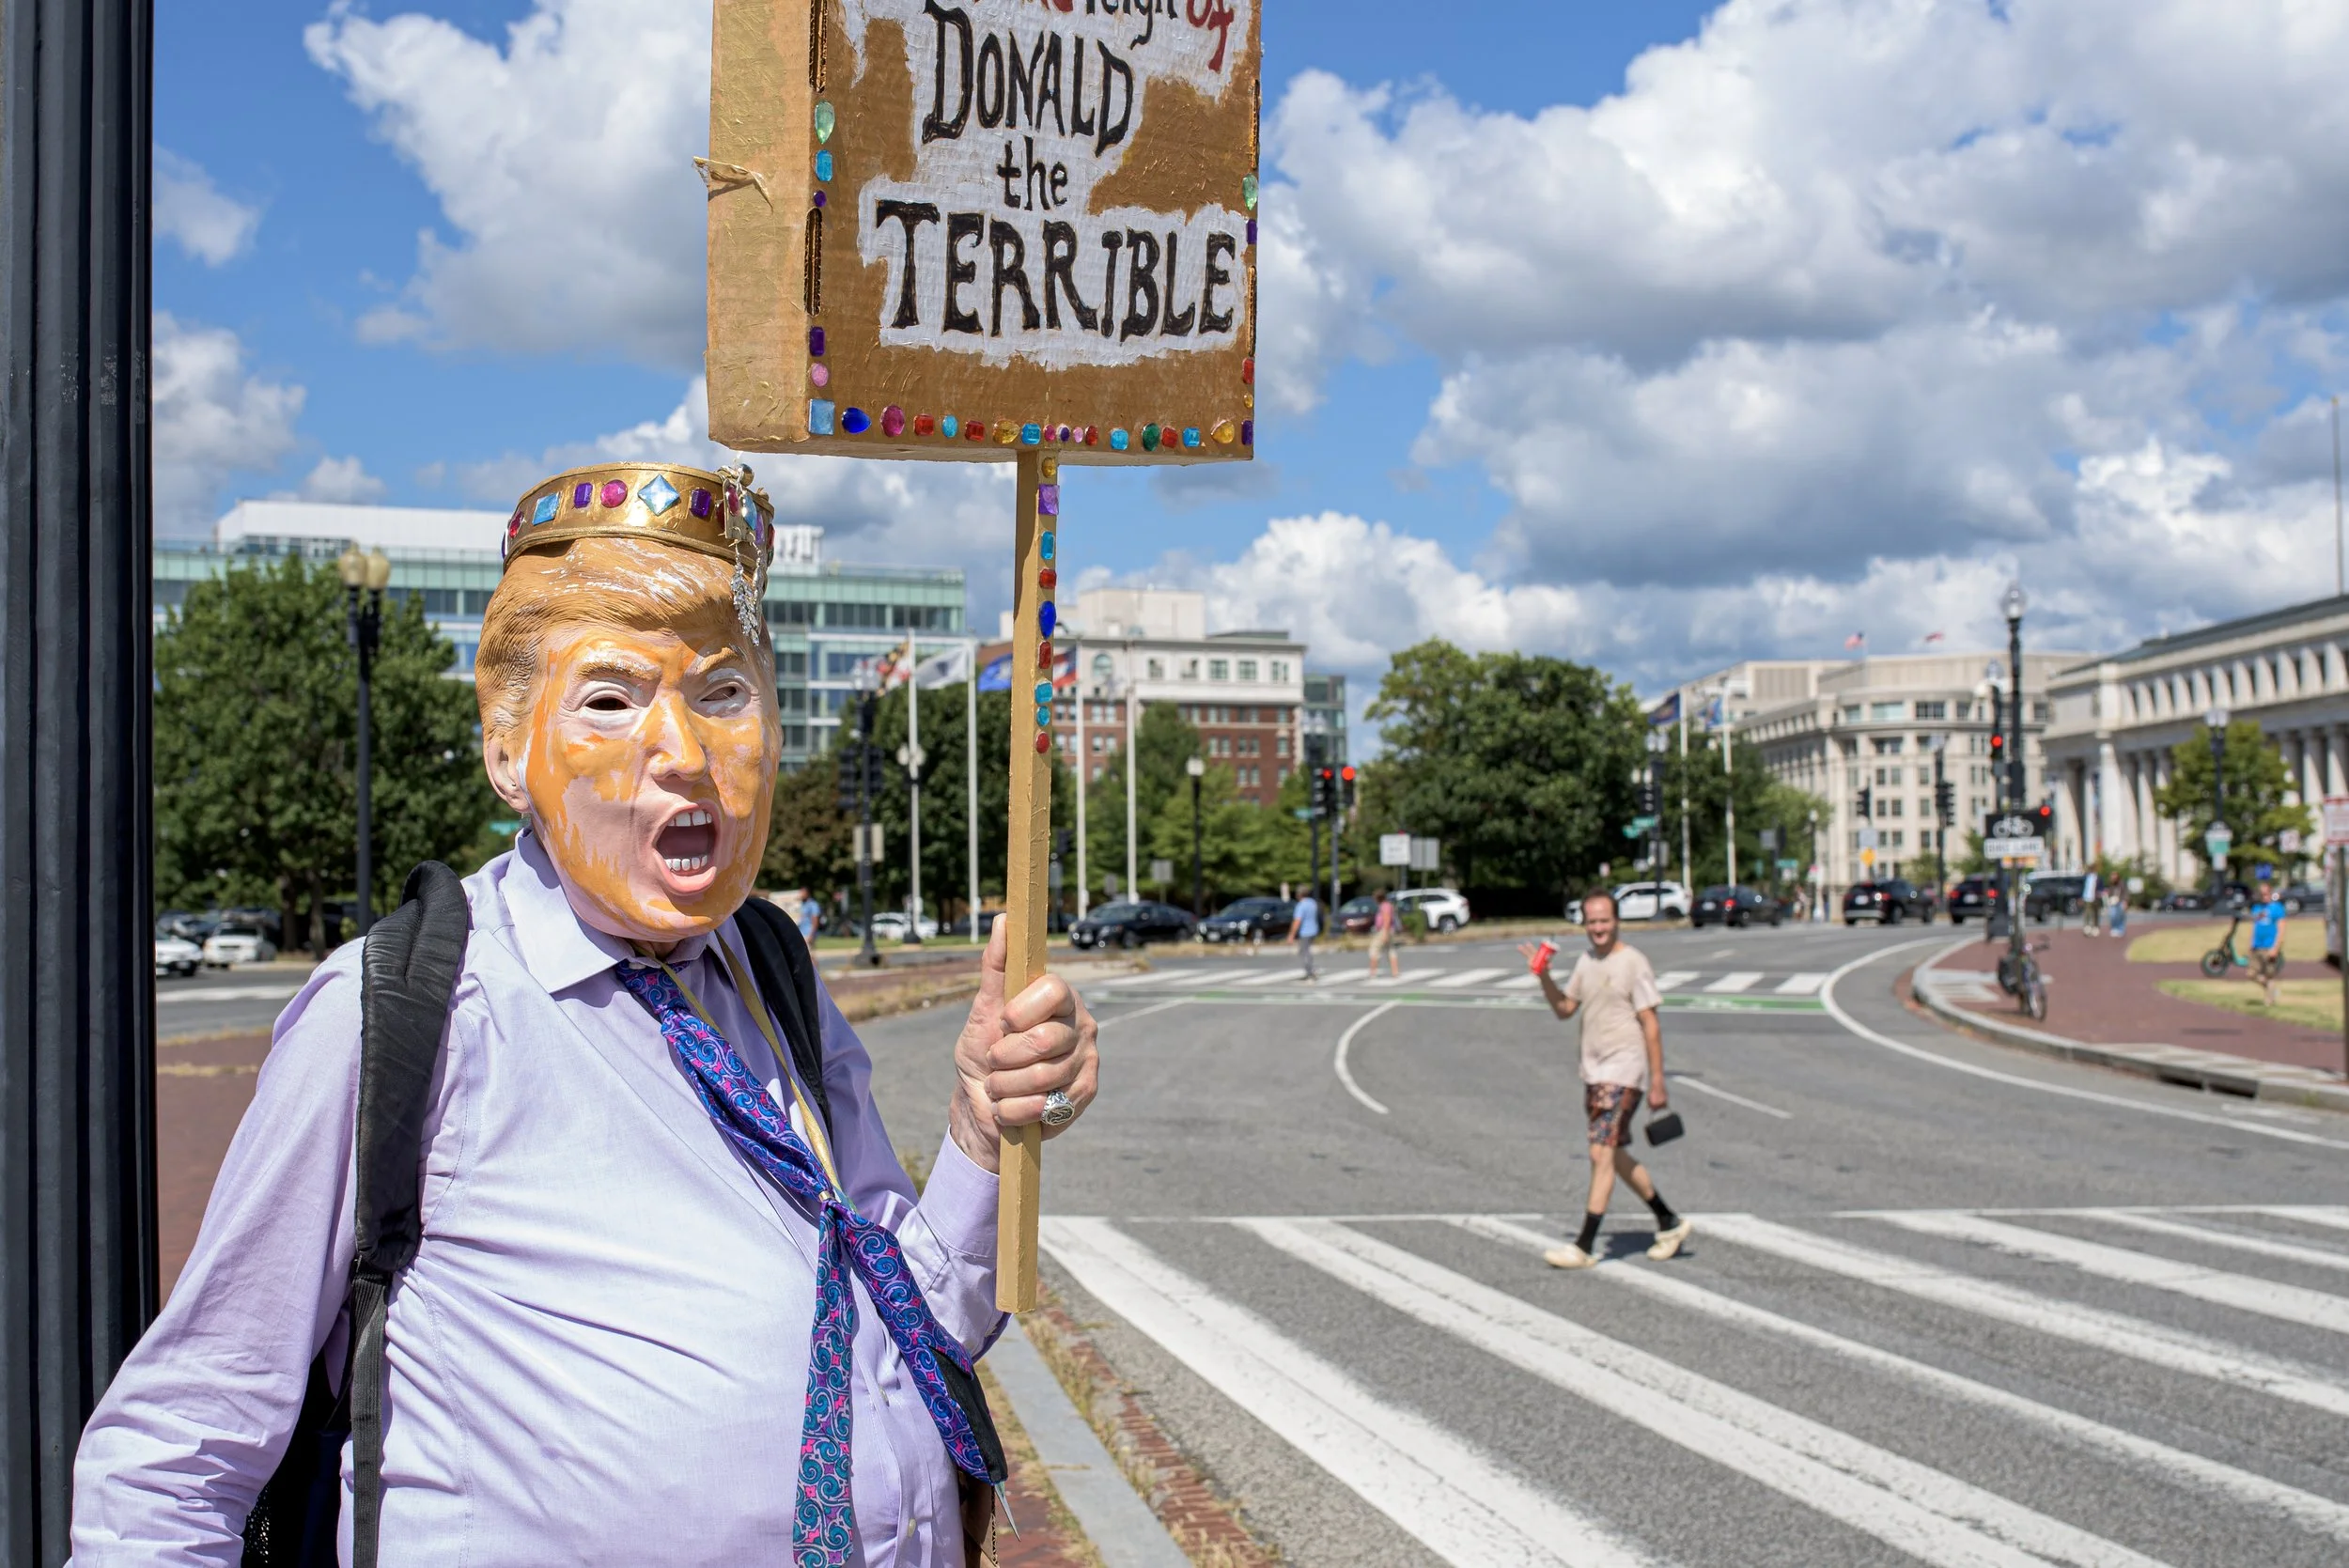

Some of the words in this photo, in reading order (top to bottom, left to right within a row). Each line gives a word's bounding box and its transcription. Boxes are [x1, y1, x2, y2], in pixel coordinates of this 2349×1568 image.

[922, 0, 1135, 160] DONALD
[996, 136, 1068, 211] the
[876, 198, 1236, 346] TERRIBLE
